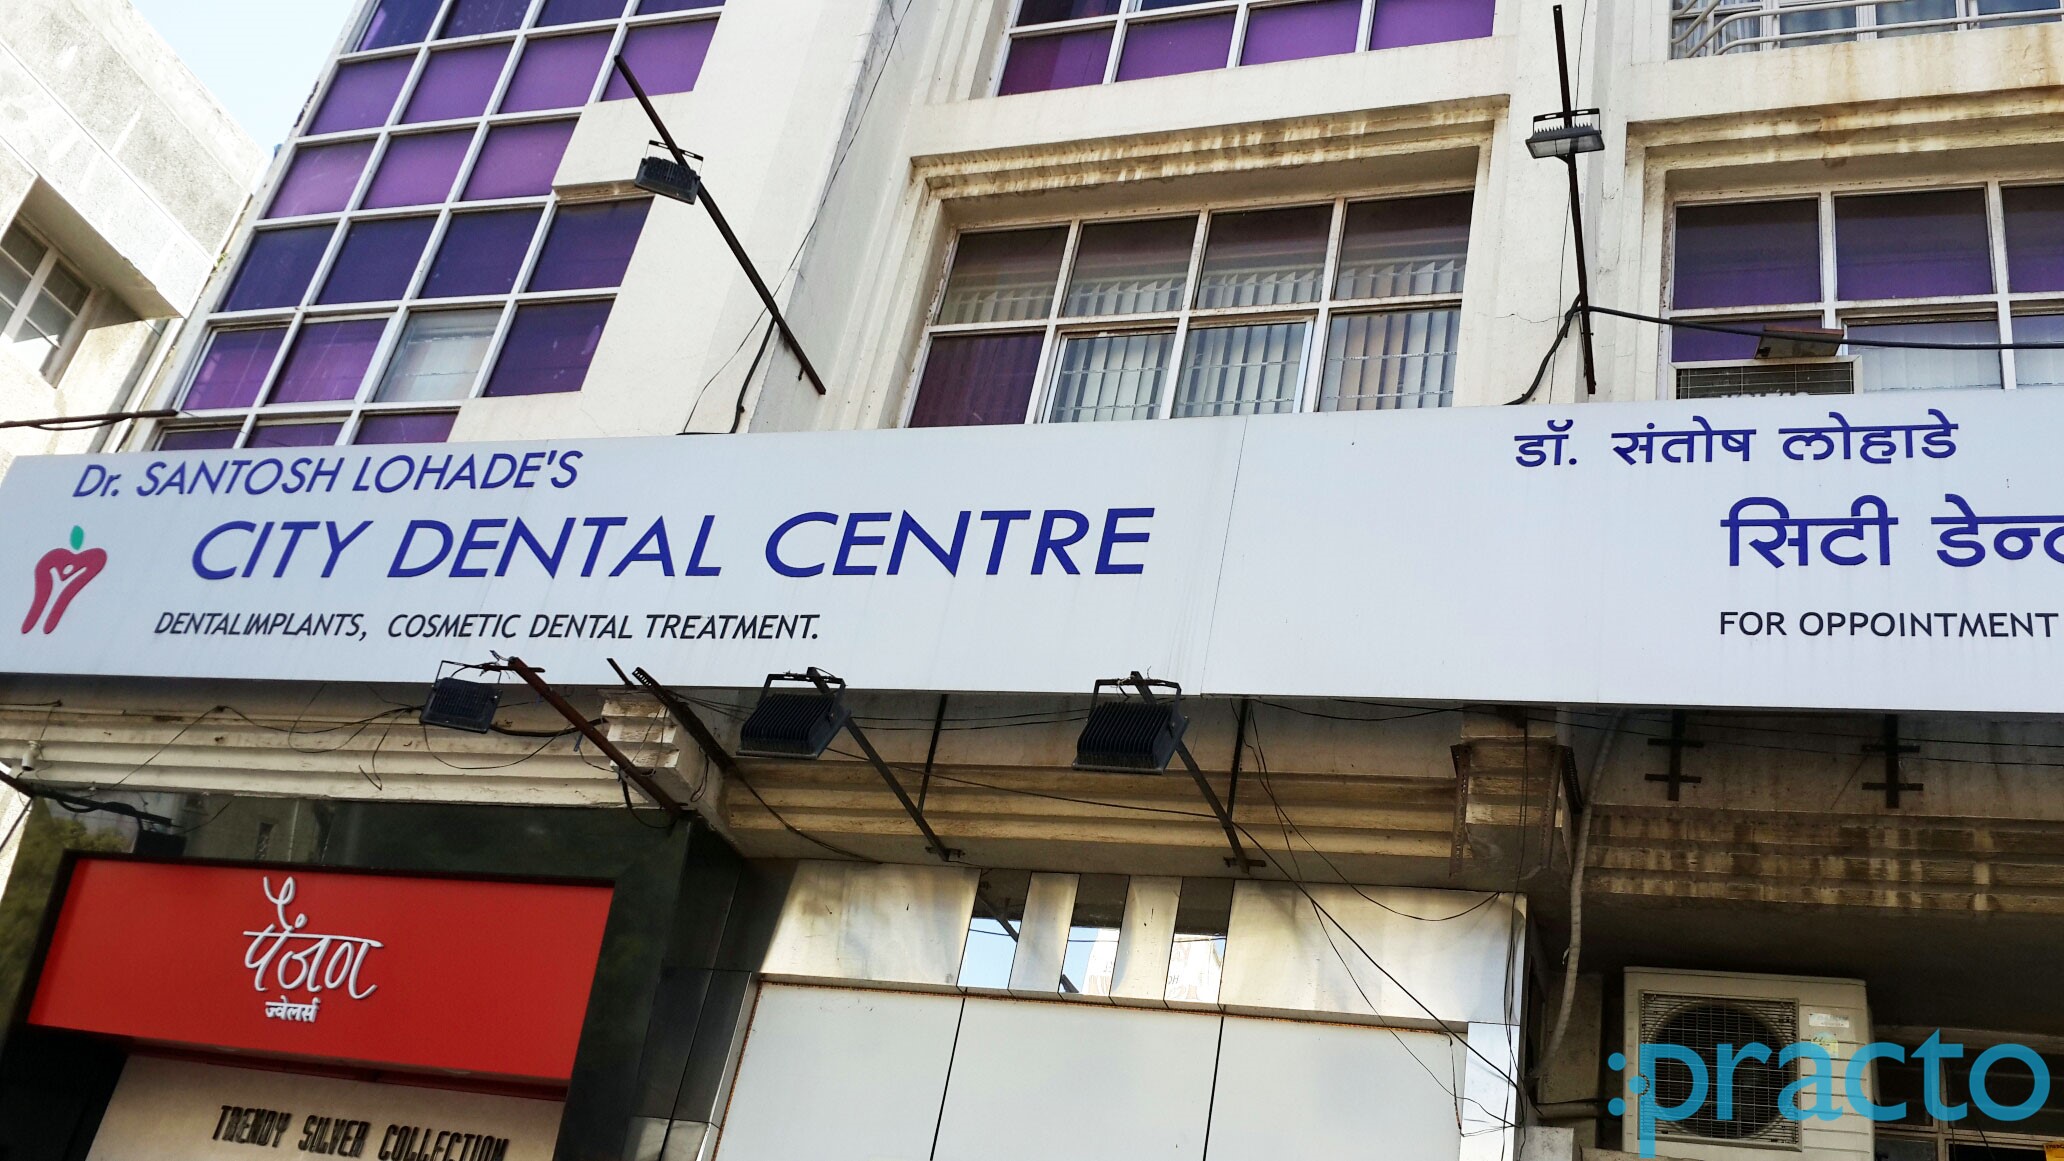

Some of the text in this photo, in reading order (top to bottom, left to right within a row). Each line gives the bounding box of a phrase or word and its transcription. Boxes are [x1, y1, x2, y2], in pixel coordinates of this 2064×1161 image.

[1514, 408, 1959, 468] डॉ. संतोष लोहाडे
[74, 450, 584, 498] Dr. SANTOSH LOHADE'S
[192, 508, 1155, 580] CITY DENTAL CENTRE
[1720, 495, 1899, 569] सिटी
[388, 614, 522, 640] COSMETIC
[529, 614, 634, 640] DENTAL
[646, 614, 821, 640] TREATMENT.
[1720, 611, 2060, 639] FOR OPPOINTMENT
[212, 1105, 511, 1161] TRENDY SILVER COLLECTION
